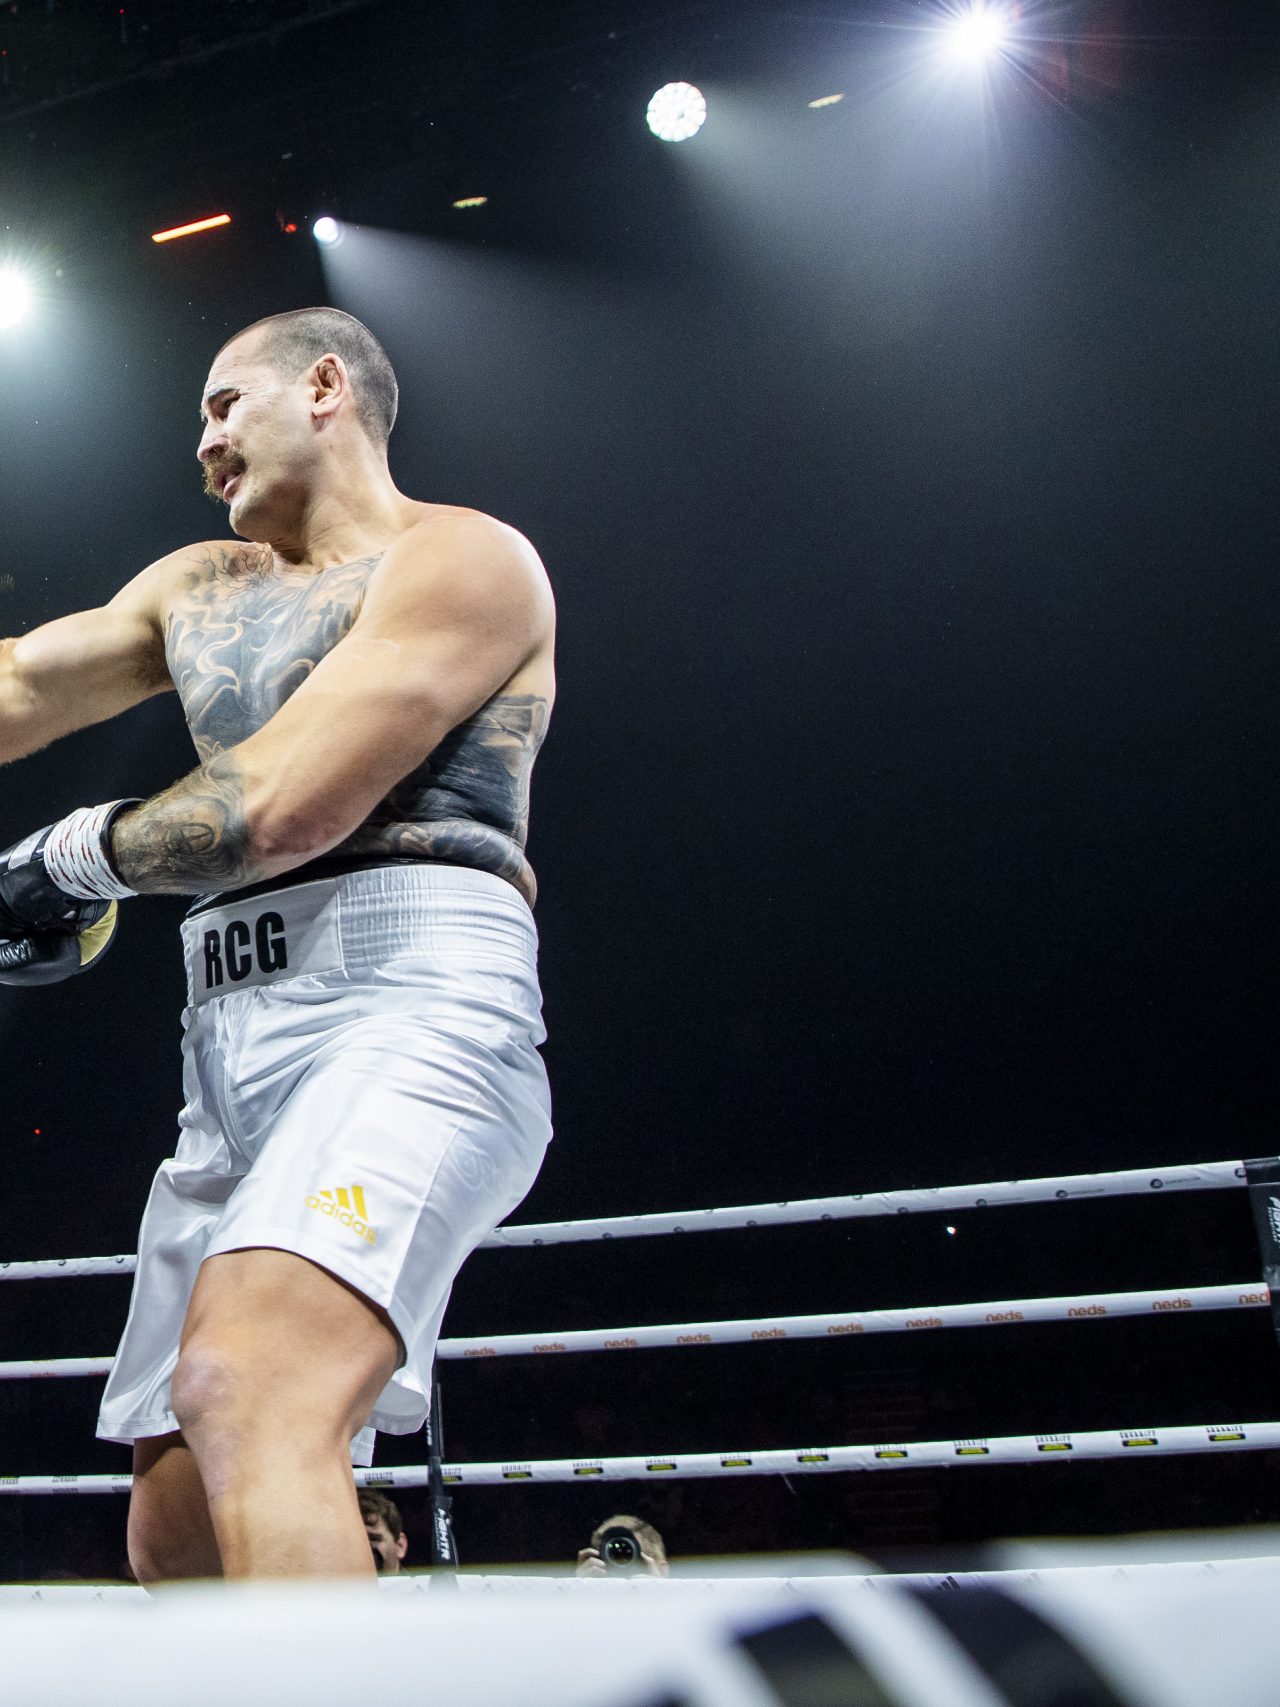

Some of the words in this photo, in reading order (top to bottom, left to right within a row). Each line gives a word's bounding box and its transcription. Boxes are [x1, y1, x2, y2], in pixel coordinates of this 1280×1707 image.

[204, 911, 287, 989] RCG
[533, 1342, 567, 1354] neds
[604, 1337, 638, 1349] neds
[677, 1333, 712, 1344] neds
[751, 1328, 786, 1339] neds
[827, 1322, 865, 1333] neds
[906, 1316, 943, 1328] neds
[986, 1310, 1024, 1322] neds
[1068, 1304, 1107, 1317] neds
[1152, 1297, 1192, 1310] neds
[1239, 1291, 1270, 1304] ned
